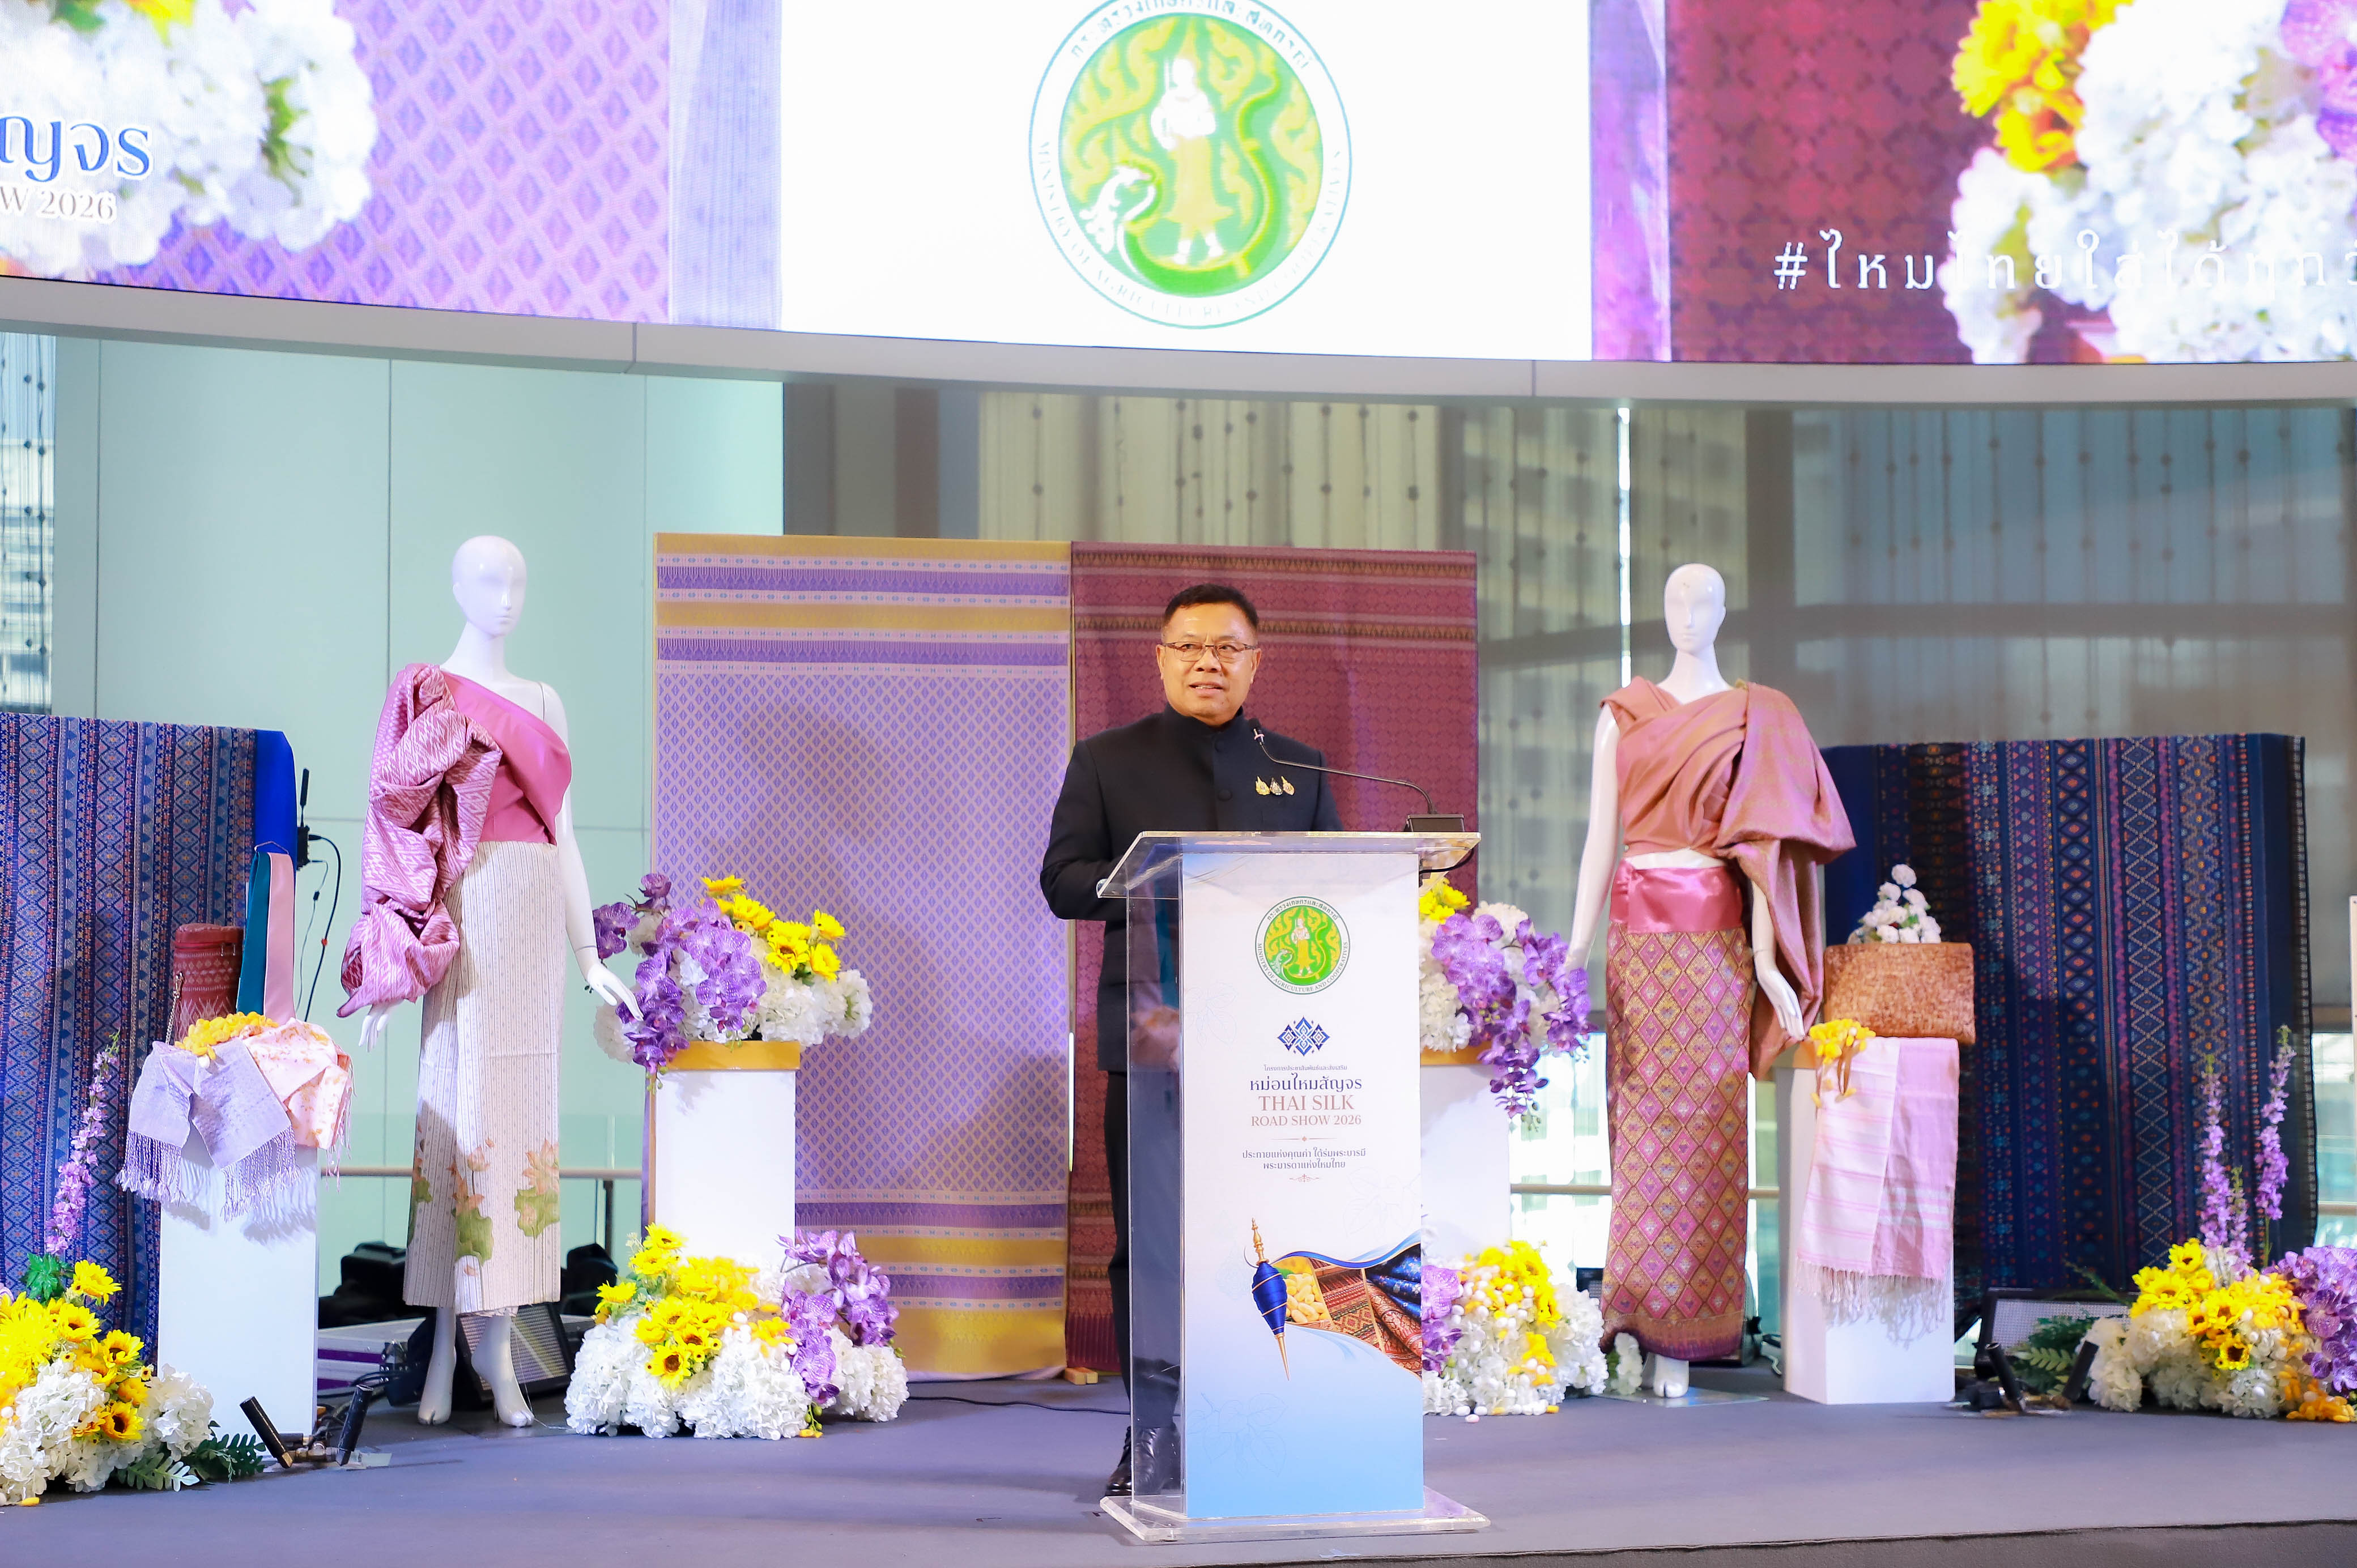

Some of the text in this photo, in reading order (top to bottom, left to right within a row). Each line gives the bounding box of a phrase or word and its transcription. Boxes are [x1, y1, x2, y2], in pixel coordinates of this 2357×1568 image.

[41, 190, 113, 220] 2026
[1257, 941, 1348, 992] MINISTRY OF AGRICULTURE AND COOPERATIVES
[1250, 1072, 1362, 1093] หม่อนไหมสัญจร
[1258, 1094, 1355, 1111] THAI SILK
[1251, 1114, 1362, 1127] ROAD SHOW 2026
[1242, 1147, 1366, 1160] ประกายแห่งคุณค่า ใต้ร่มพระบารมี
[1263, 1158, 1346, 1169] พระมารดาแห่งไหมไทย
